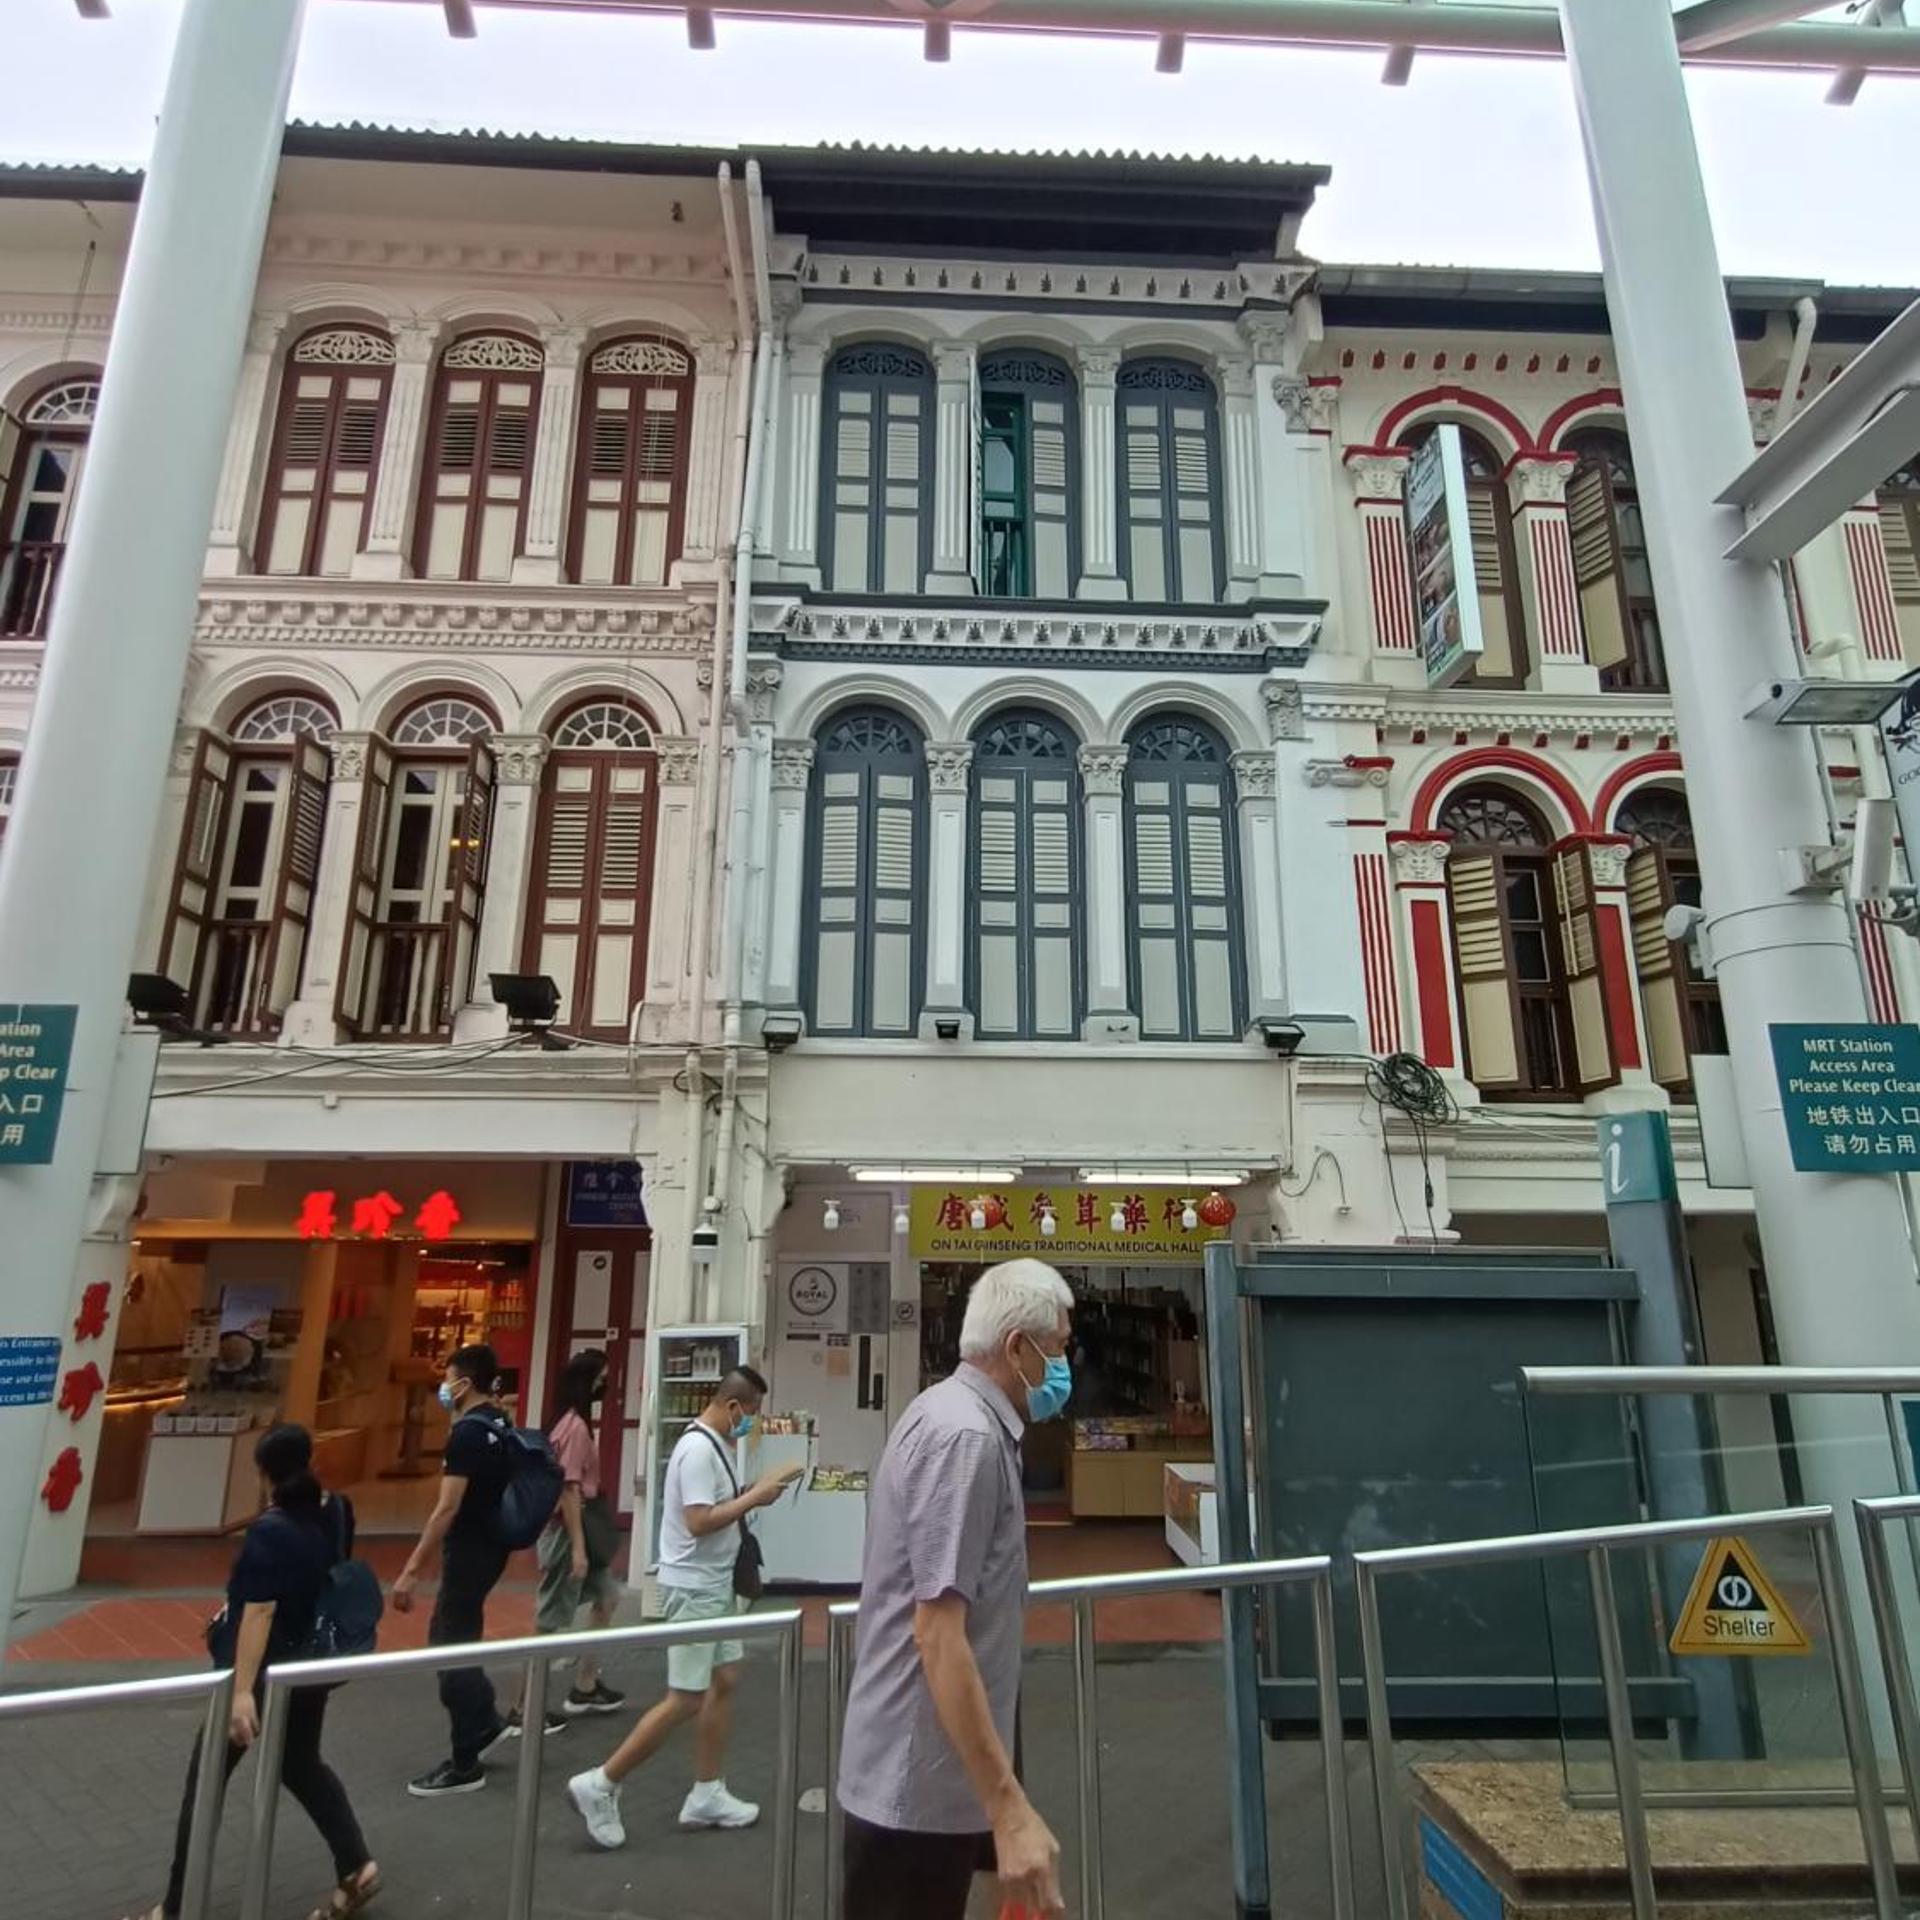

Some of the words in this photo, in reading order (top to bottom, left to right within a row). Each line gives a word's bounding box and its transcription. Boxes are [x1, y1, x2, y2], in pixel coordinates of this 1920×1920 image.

[1803, 1039, 1835, 1052] MRT
[1840, 1038, 1893, 1053] Station
[14, 1064, 58, 1080] Clear
[1809, 1060, 1857, 1073] Access
[1861, 1060, 1896, 1073] Area
[1789, 1079, 1838, 1093] Please
[1843, 1079, 1880, 1095] Keep
[1806, 1104, 1920, 1126] 地铁出入口
[1824, 1134, 1916, 1154] 请勿占用
[931, 1239, 951, 1250] ON
[954, 1239, 972, 1250] TAI
[974, 1239, 1032, 1251] GINSENG
[1034, 1240, 1111, 1252] TRADITIONAL
[1114, 1241, 1168, 1252] MEDICAL
[1171, 1241, 1200, 1252] HALL
[1703, 1615, 1776, 1637] Shelter
